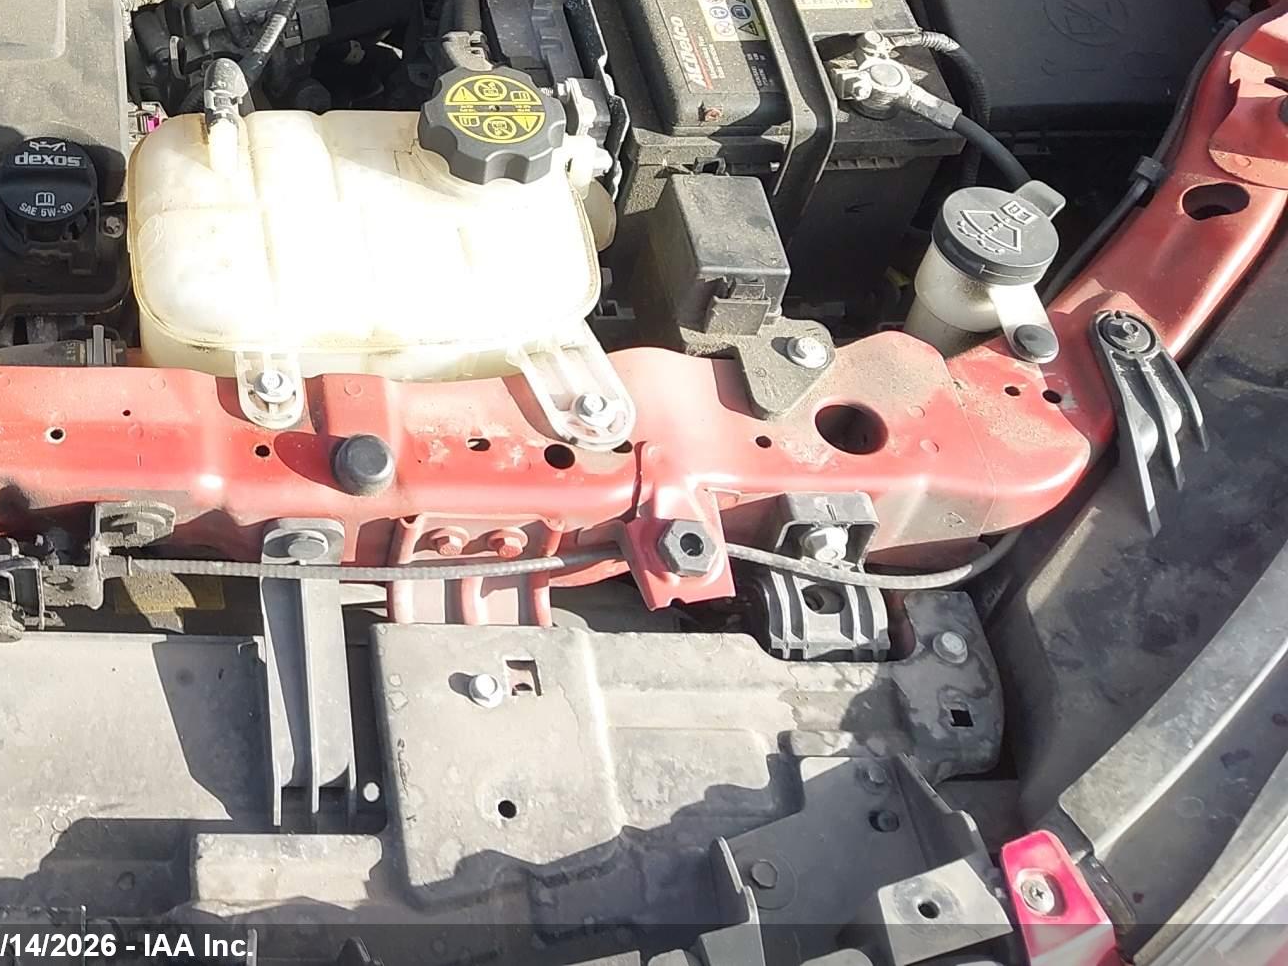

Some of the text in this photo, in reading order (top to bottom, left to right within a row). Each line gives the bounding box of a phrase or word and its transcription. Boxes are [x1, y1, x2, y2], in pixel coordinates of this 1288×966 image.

[670, 16, 707, 88] ACDelco
[14, 151, 82, 167] dexos
[19, 202, 73, 218] SAE 5W-30
